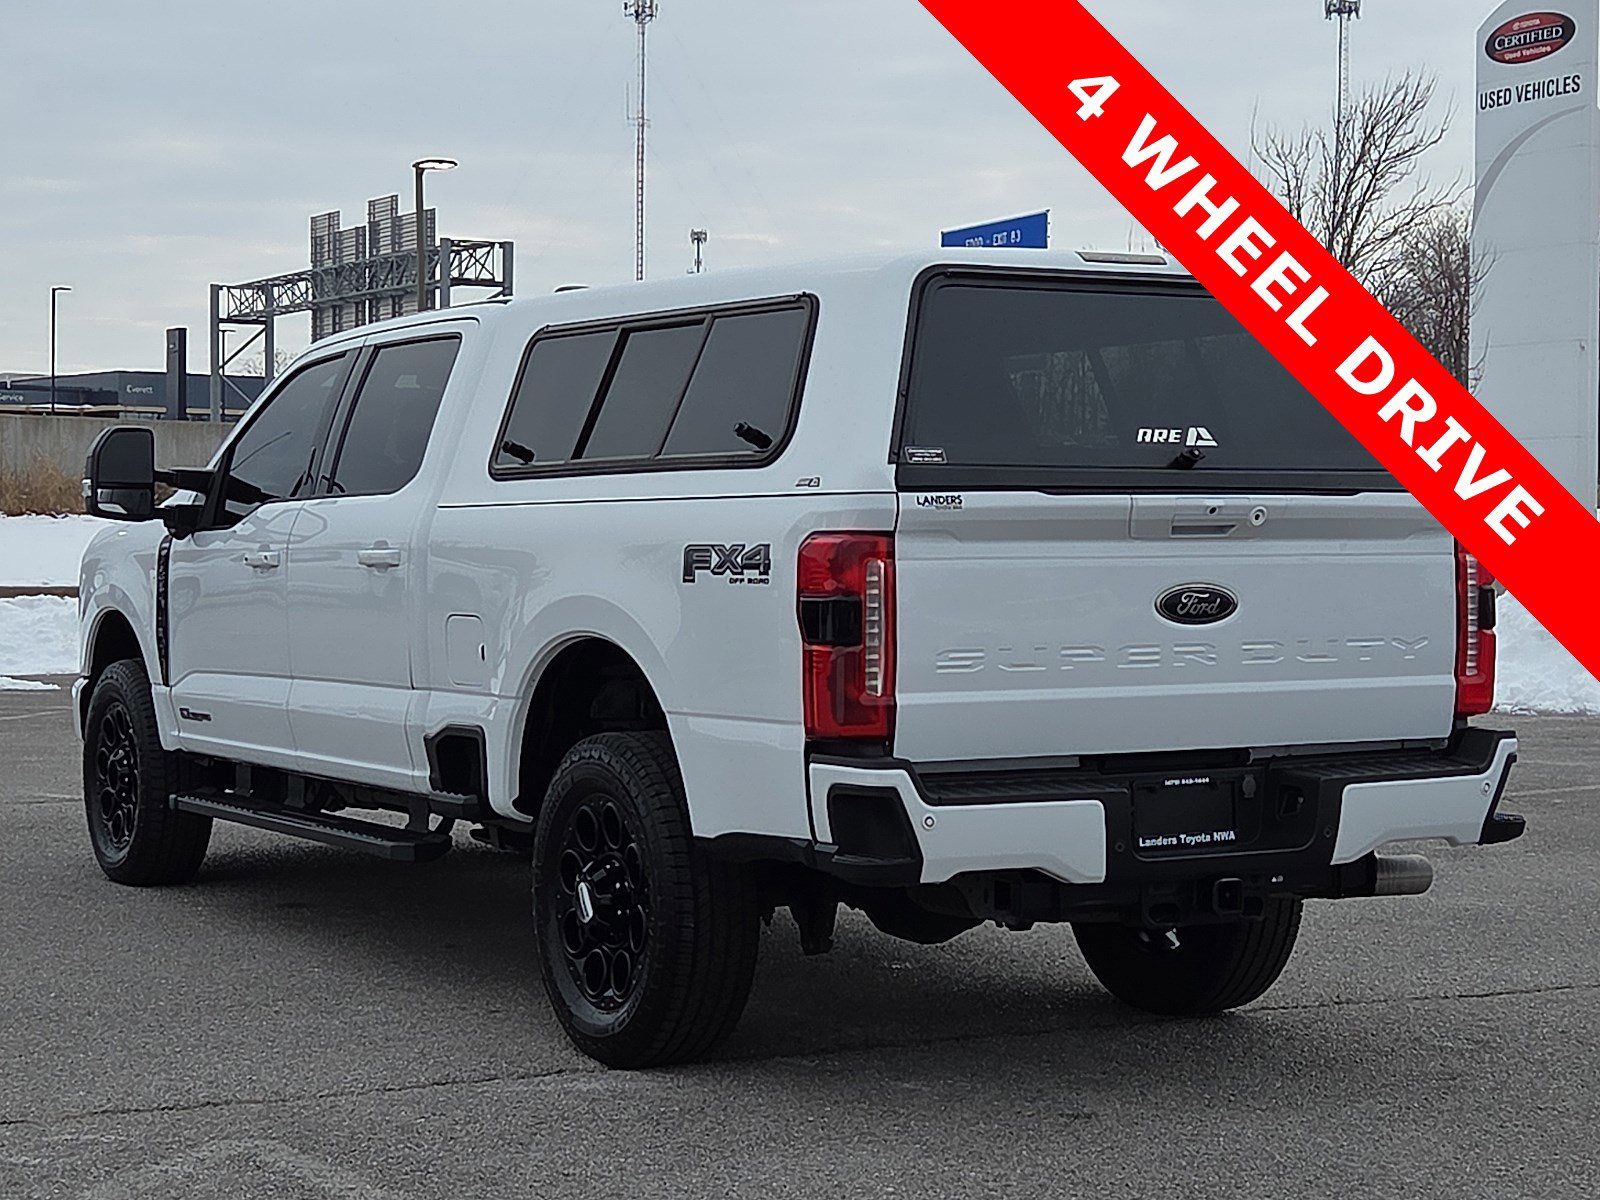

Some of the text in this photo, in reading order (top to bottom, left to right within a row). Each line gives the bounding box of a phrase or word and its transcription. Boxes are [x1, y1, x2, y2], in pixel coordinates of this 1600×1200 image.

[1494, 26, 1563, 50] CERTIFIED
[1480, 74, 1581, 110] USED VEHICLES
[1137, 428, 1182, 443] ARE
[916, 495, 962, 506] LANDERS
[683, 544, 770, 583] FX4
[729, 577, 770, 585] OFF ROAD
[1177, 592, 1221, 615] Ford
[936, 637, 1428, 673] SUPER DUTY
[1139, 831, 1235, 847] Landers Toyota NWA
